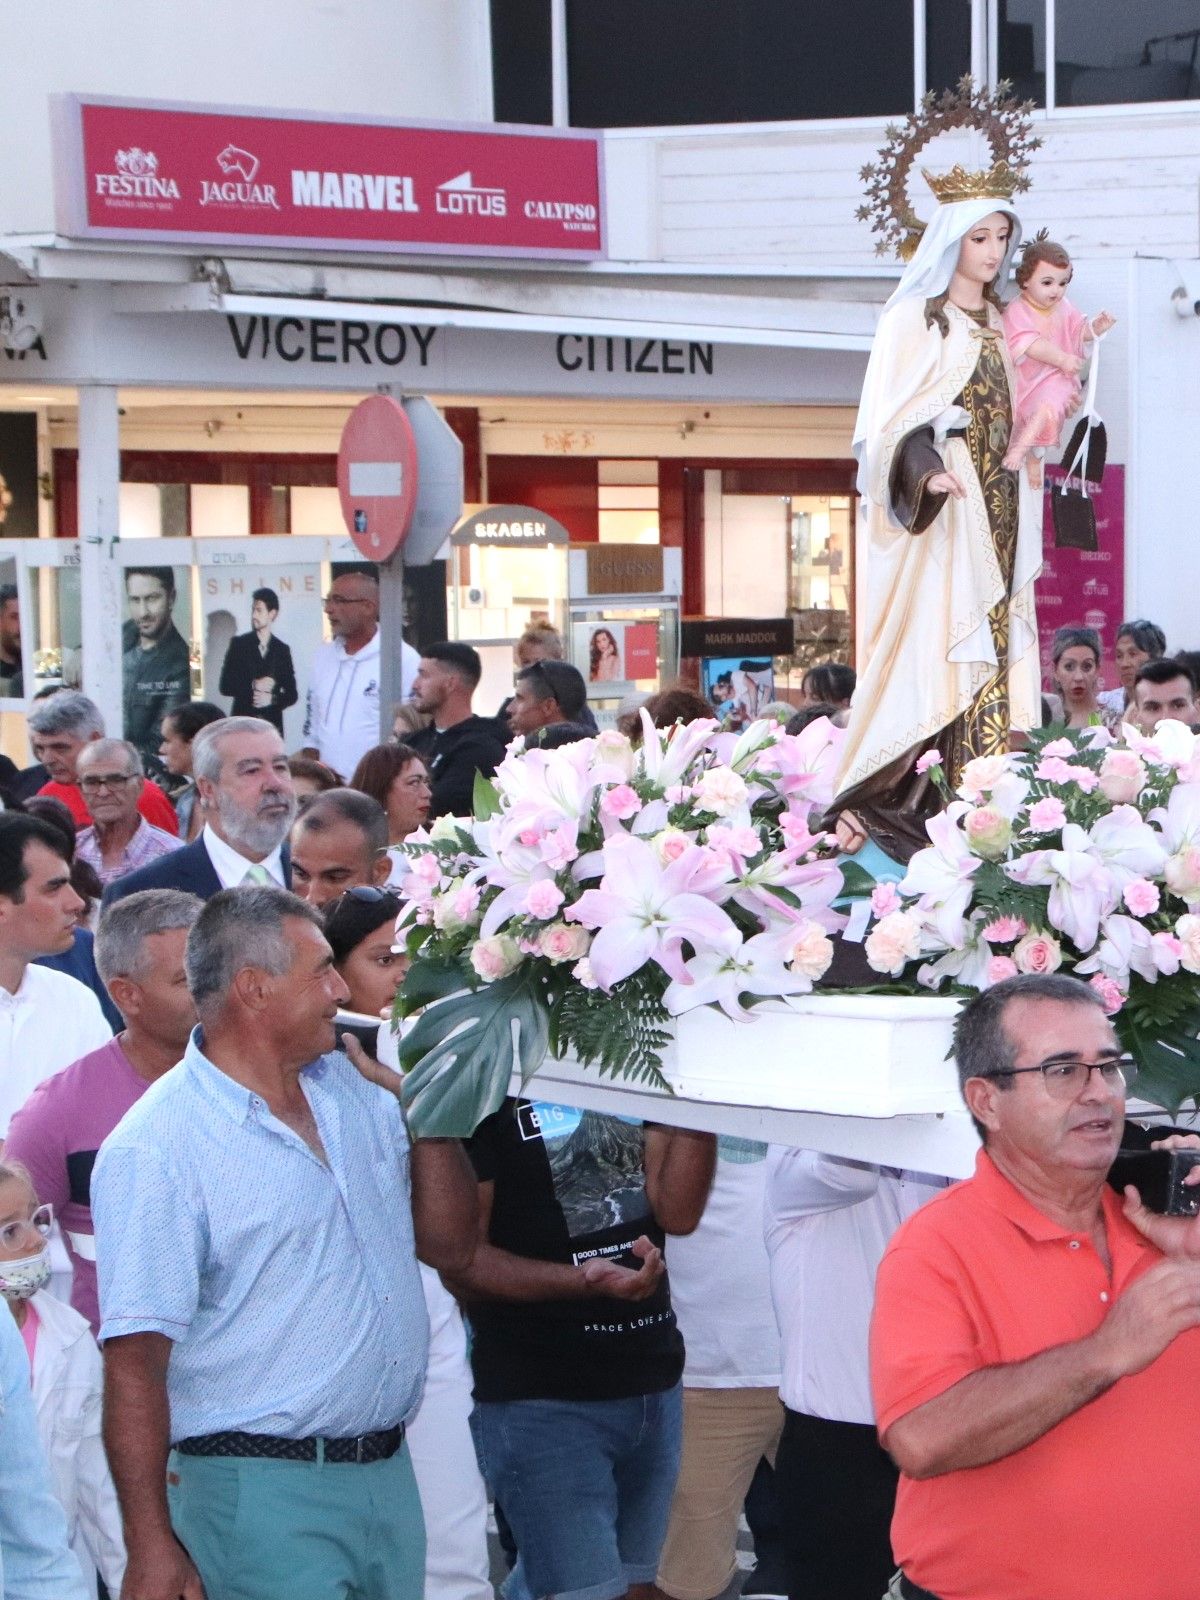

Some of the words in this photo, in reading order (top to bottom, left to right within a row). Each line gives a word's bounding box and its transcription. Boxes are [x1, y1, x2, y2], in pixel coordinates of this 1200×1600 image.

[95, 173, 181, 200] FESTINA
[200, 181, 281, 211] JAGUAR
[291, 170, 418, 212] MARVEL
[435, 192, 506, 217] LOTUS
[523, 200, 597, 221] CALYPSO
[226, 314, 437, 367] VICEROY
[555, 333, 714, 375] CITIZEN
[474, 522, 547, 538] SKAGEN
[704, 632, 733, 644] MARK
[735, 631, 778, 644] MADDOX
[529, 1105, 565, 1128] BIG
[577, 1249, 598, 1259] GOOD
[599, 1244, 619, 1255] TIMES
[584, 1323, 623, 1332] PEACE
[630, 1316, 654, 1329] LOVE
